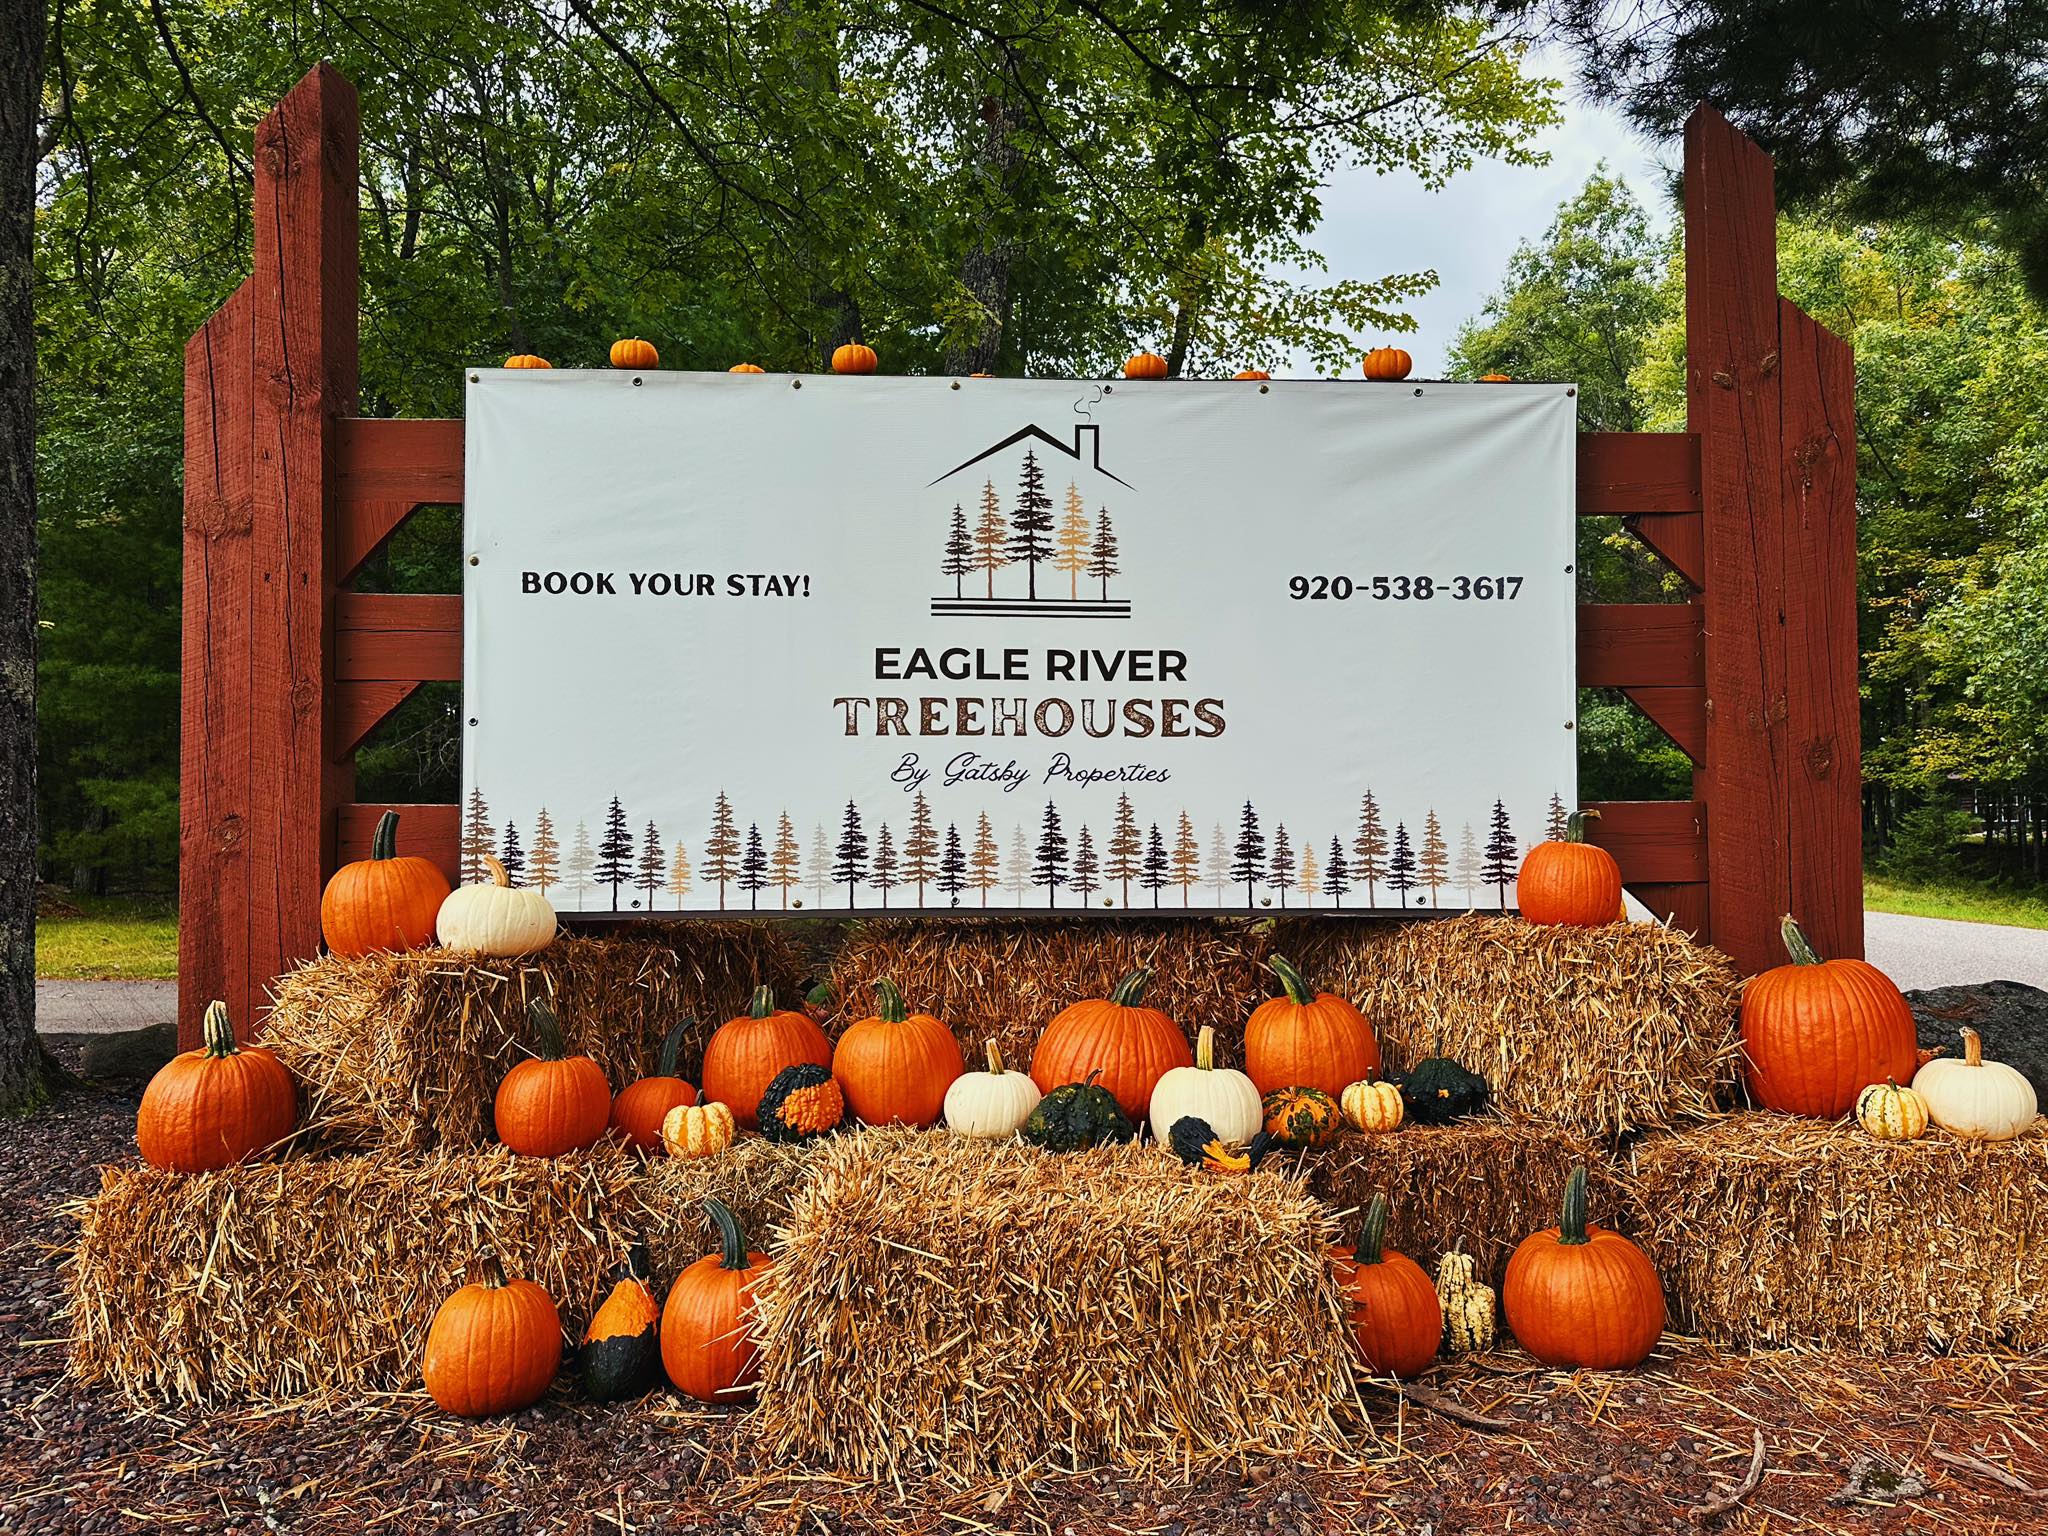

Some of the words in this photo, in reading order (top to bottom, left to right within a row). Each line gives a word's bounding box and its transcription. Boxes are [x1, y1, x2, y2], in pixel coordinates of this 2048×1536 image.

[522, 572, 616, 594] BOOK
[629, 573, 715, 596] YOUR
[727, 574, 810, 597] STAY!
[1289, 576, 1524, 600] 920-538-3617
[876, 648, 1029, 680] EAGLE
[1047, 650, 1187, 681] RIVER
[833, 697, 1226, 738] TREEHOUSES
[891, 753, 931, 793] By
[943, 752, 1031, 793] Gatsby
[1043, 753, 1171, 788] Properties
